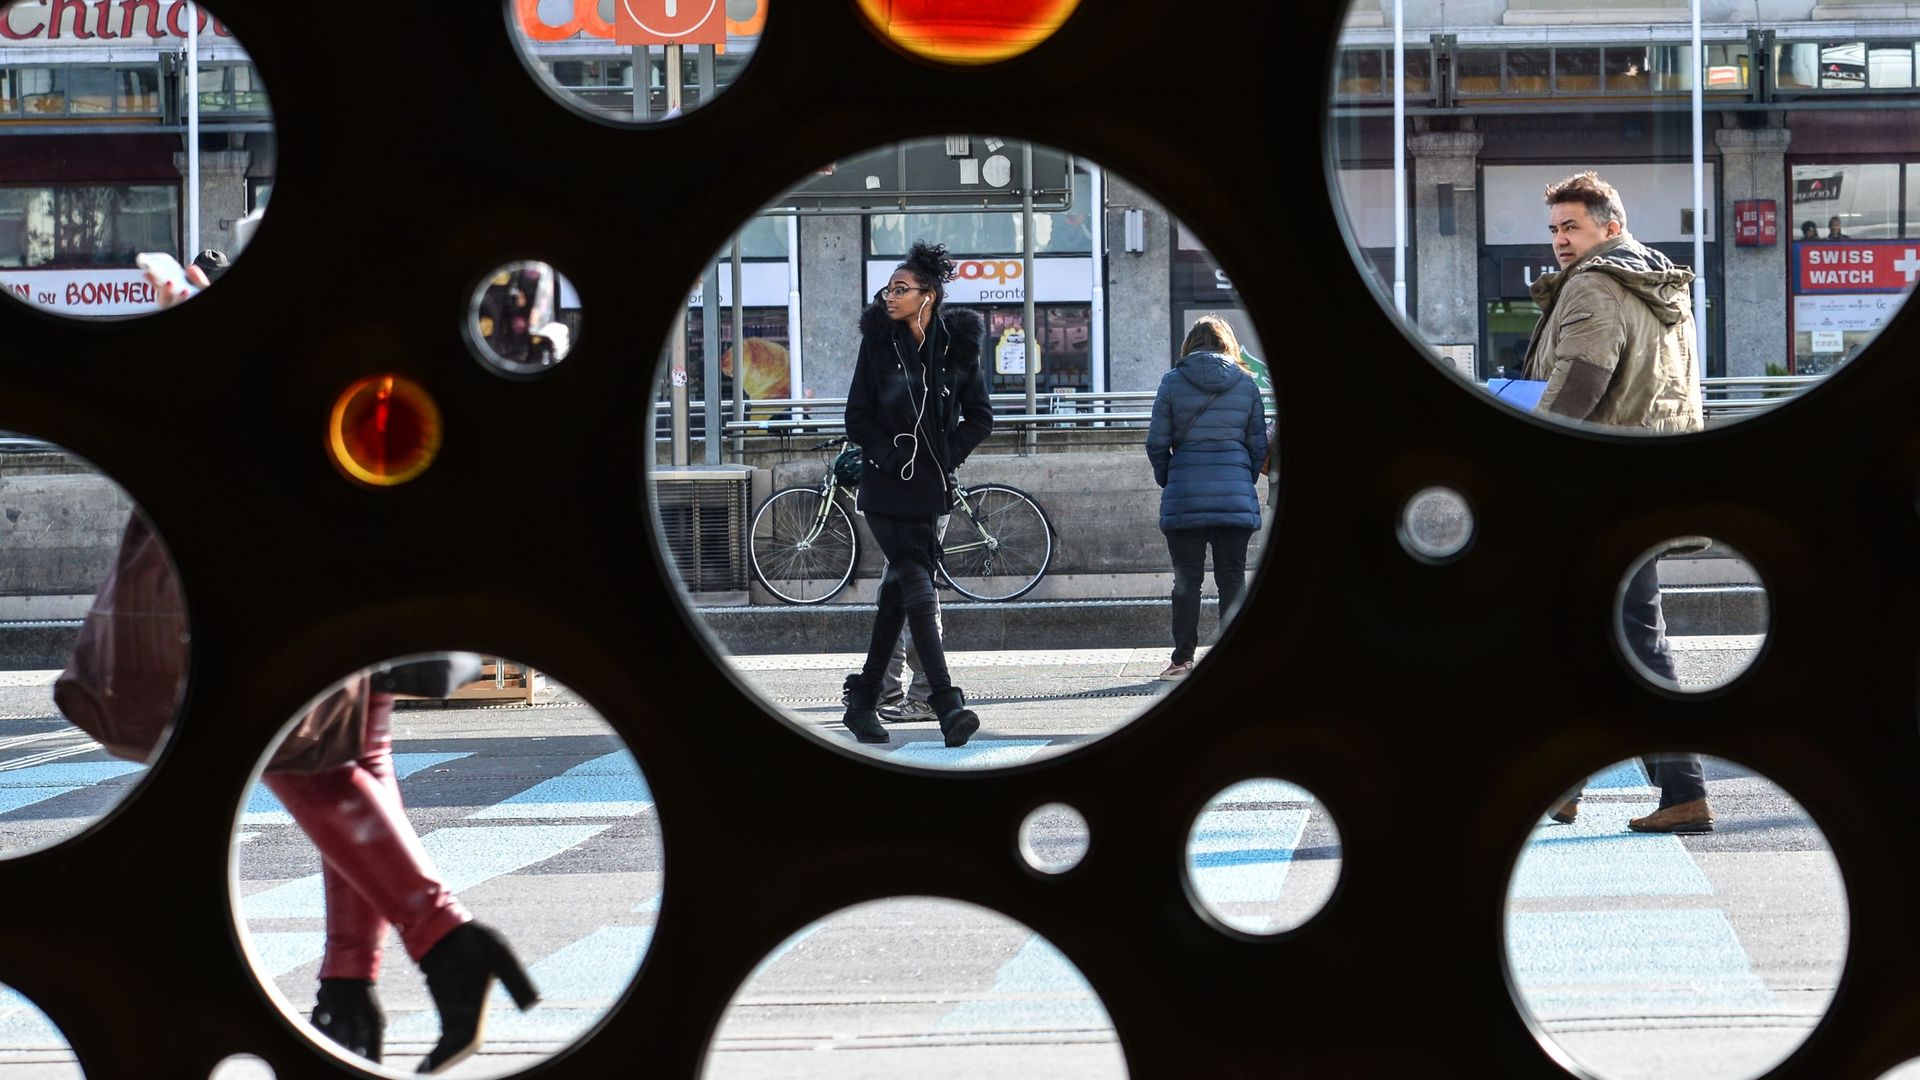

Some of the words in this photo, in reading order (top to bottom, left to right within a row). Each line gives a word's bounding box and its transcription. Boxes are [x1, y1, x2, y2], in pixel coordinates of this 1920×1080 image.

[1809, 250, 1874, 264] SWISS
[1810, 270, 1874, 284] WATCH
[66, 282, 156, 305] BONHEU
